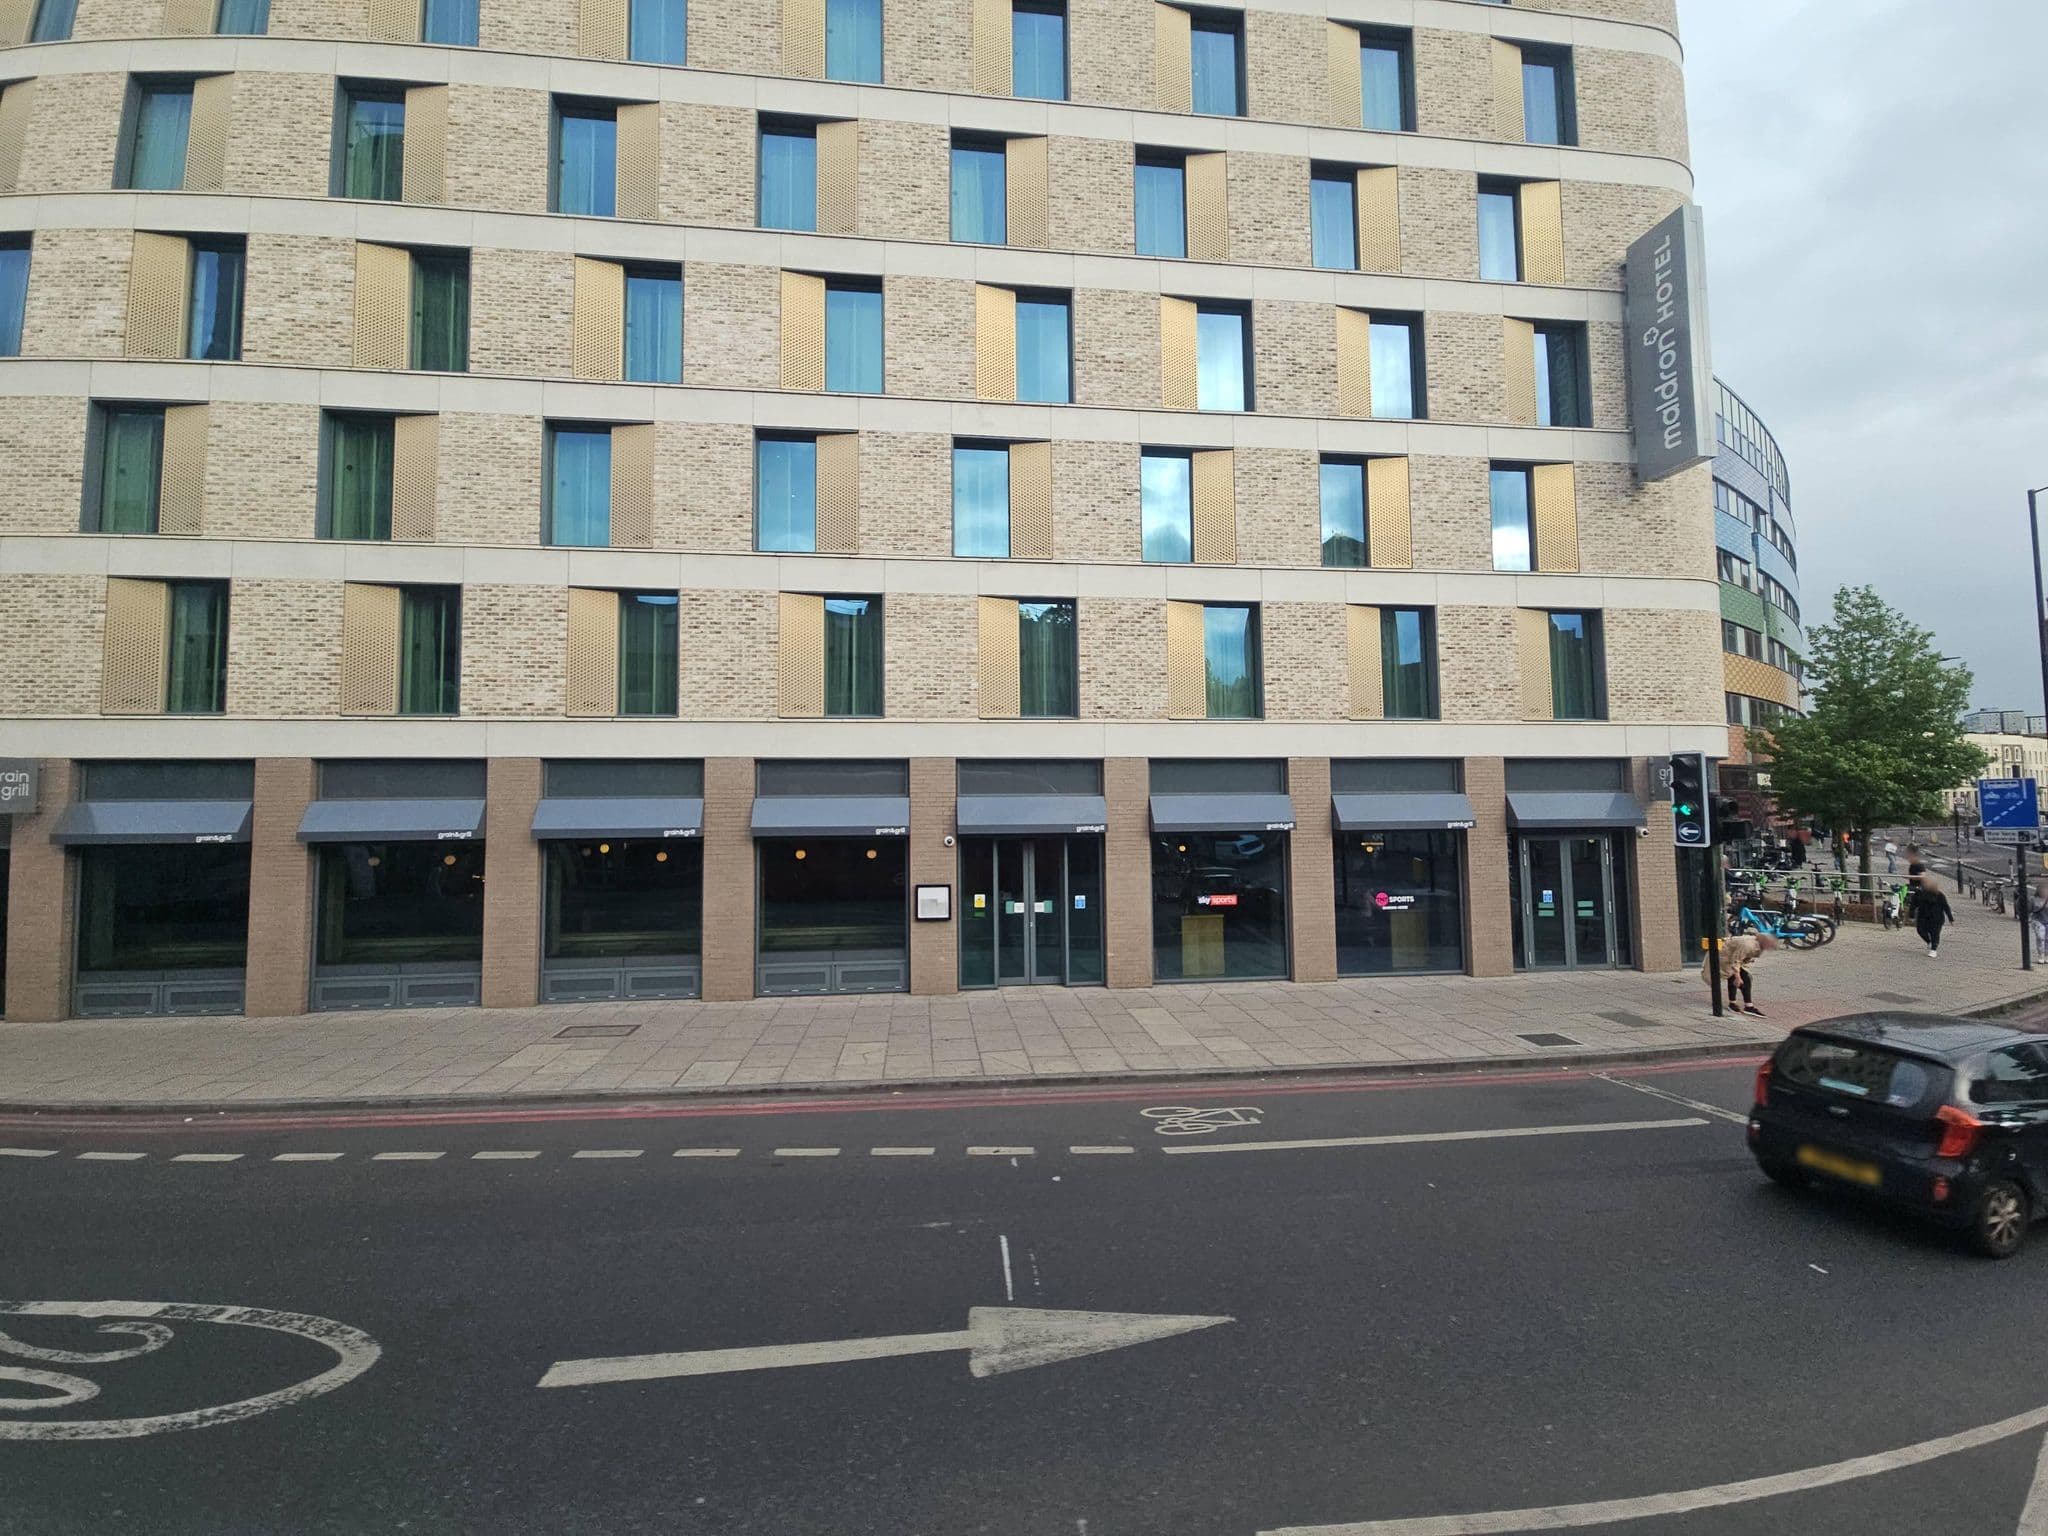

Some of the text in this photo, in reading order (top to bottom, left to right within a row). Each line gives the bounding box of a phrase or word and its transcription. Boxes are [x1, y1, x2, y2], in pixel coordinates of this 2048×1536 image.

[1654, 234, 1682, 450] maldron HOTEL
[0, 769, 30, 783] rain
[1, 783, 30, 801] grill
